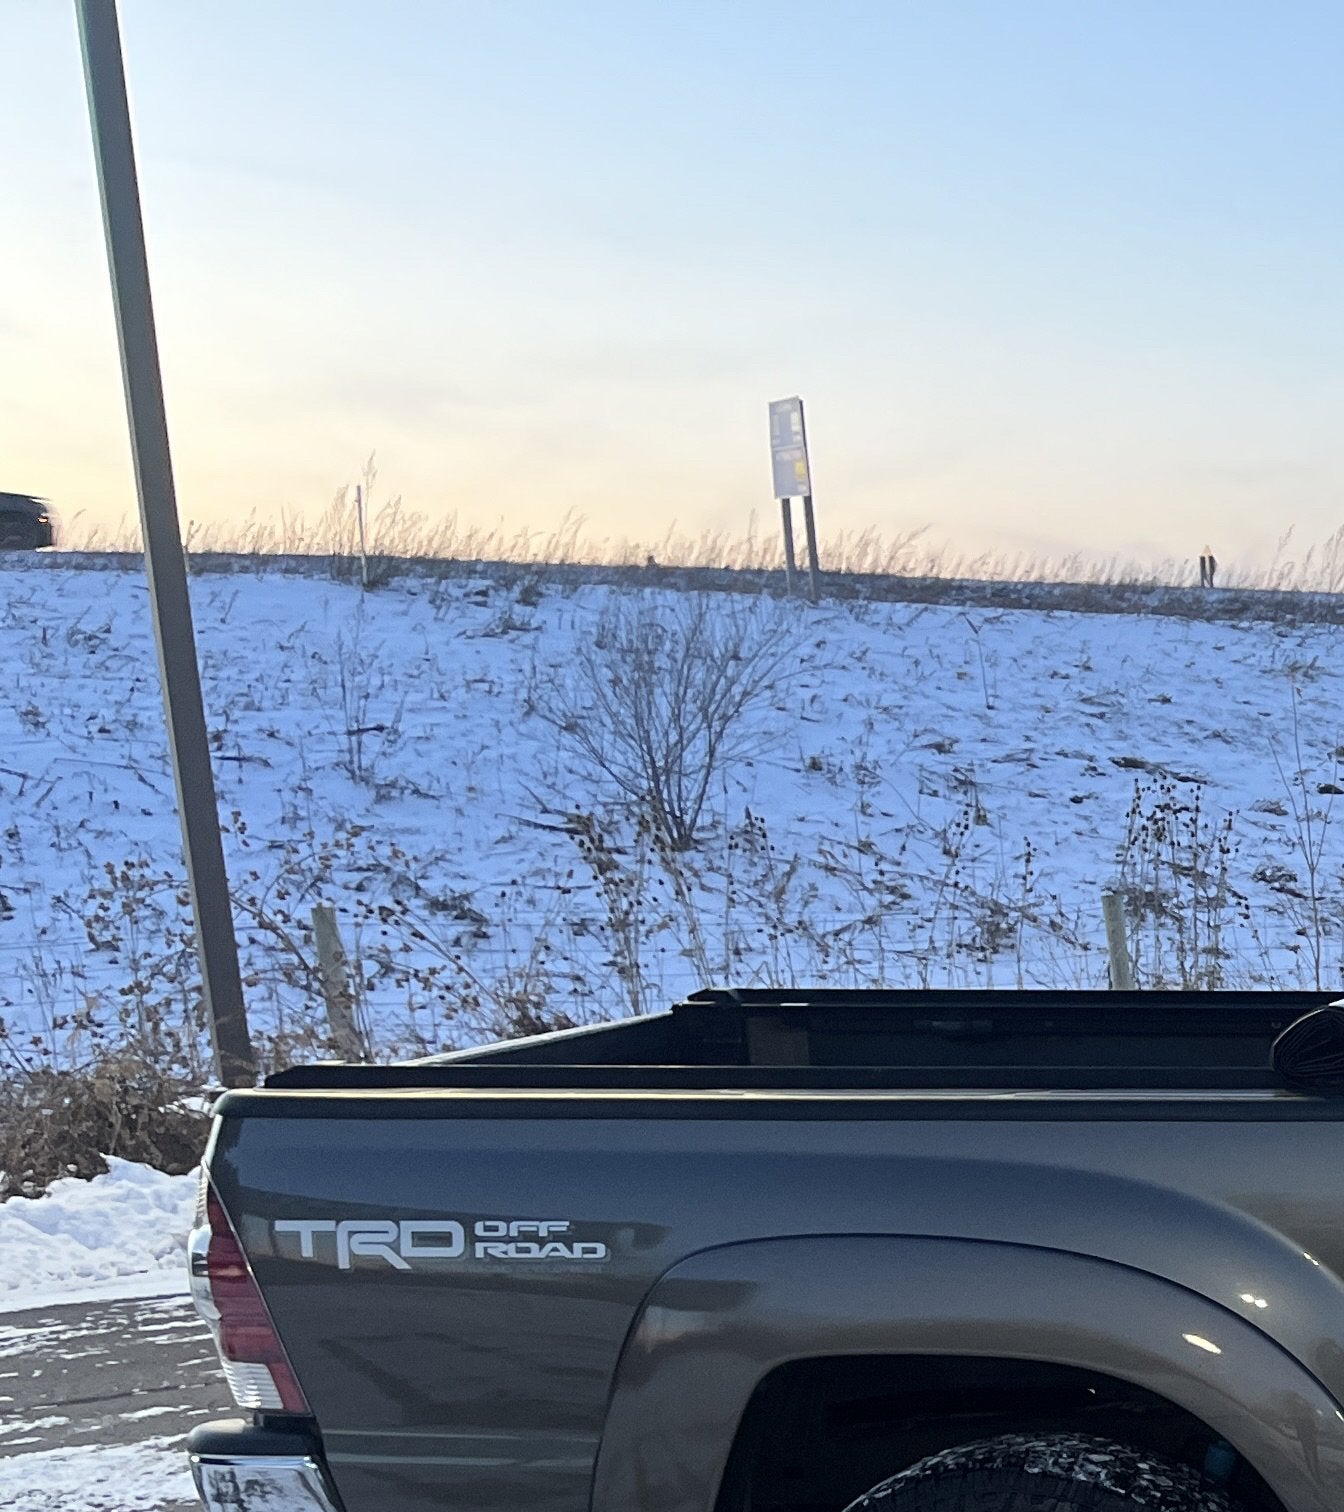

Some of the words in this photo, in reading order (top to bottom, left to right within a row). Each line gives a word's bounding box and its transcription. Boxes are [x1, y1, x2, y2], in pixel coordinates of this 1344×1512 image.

[474, 1220, 570, 1237] OFF
[274, 1219, 465, 1270] TRD
[474, 1242, 606, 1259] ROAD
